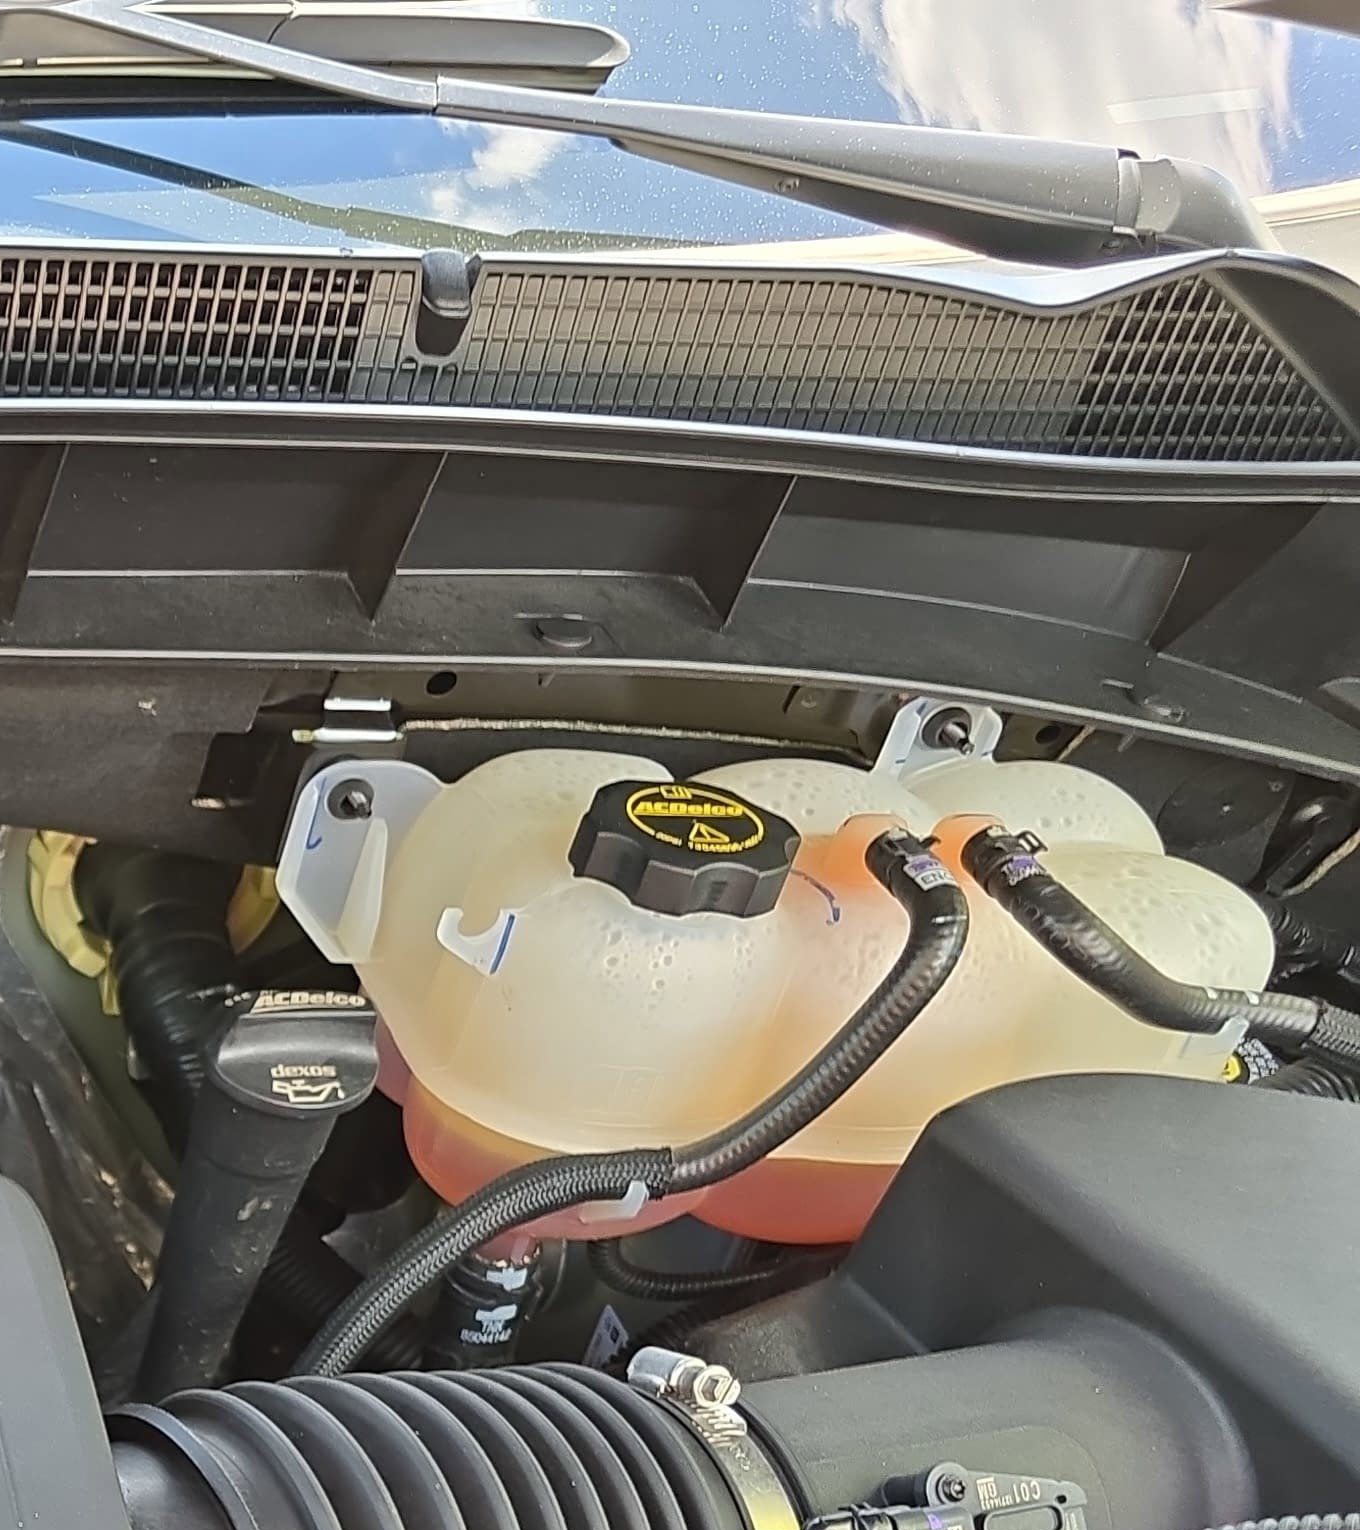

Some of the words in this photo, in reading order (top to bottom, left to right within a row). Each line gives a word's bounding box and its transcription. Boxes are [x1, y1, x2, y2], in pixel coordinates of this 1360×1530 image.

[633, 801, 744, 818] ACDelco
[251, 990, 366, 1011] ACDelco
[270, 1064, 337, 1079] dexos
[1012, 1479, 1041, 1504] C01
